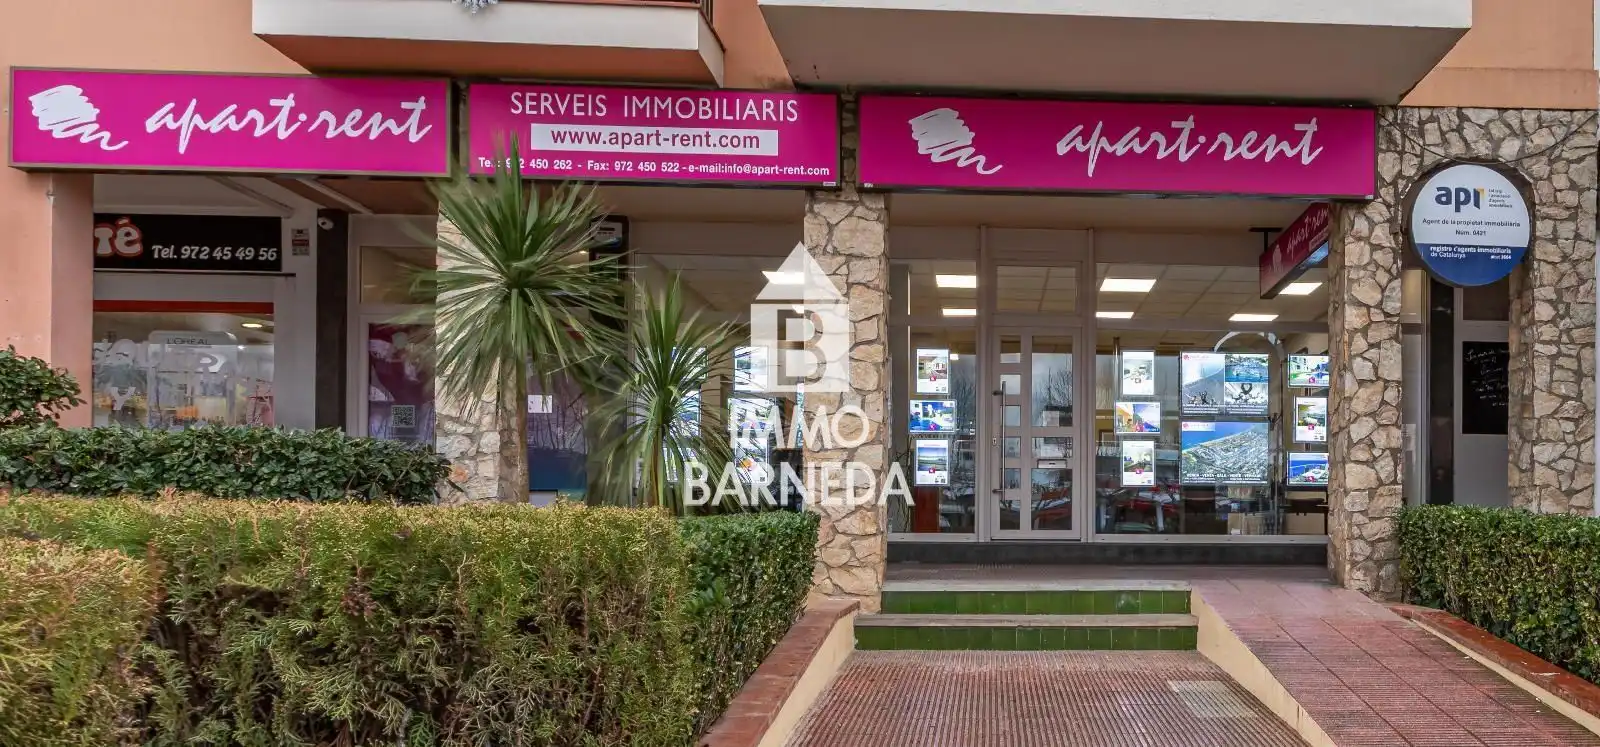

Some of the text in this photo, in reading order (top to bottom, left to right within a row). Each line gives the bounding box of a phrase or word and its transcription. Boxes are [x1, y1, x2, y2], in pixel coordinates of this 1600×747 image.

[510, 92, 799, 122] SERVEIS IMMOBILIARIS
[551, 129, 760, 151] www.apart-rent.com
[506, 158, 525, 169] 92
[529, 159, 549, 169] 450
[553, 159, 573, 170] 262
[587, 160, 610, 171] Fax:
[614, 161, 633, 172] 972
[637, 161, 657, 172] 450
[661, 162, 680, 172] 522
[688, 162, 830, 177] e-mail:info@apart-rent.com
[1422, 218, 1440, 226] Agent
[1456, 219, 1483, 227] propietat
[152, 245, 277, 261] Tel. 972 45 49 56
